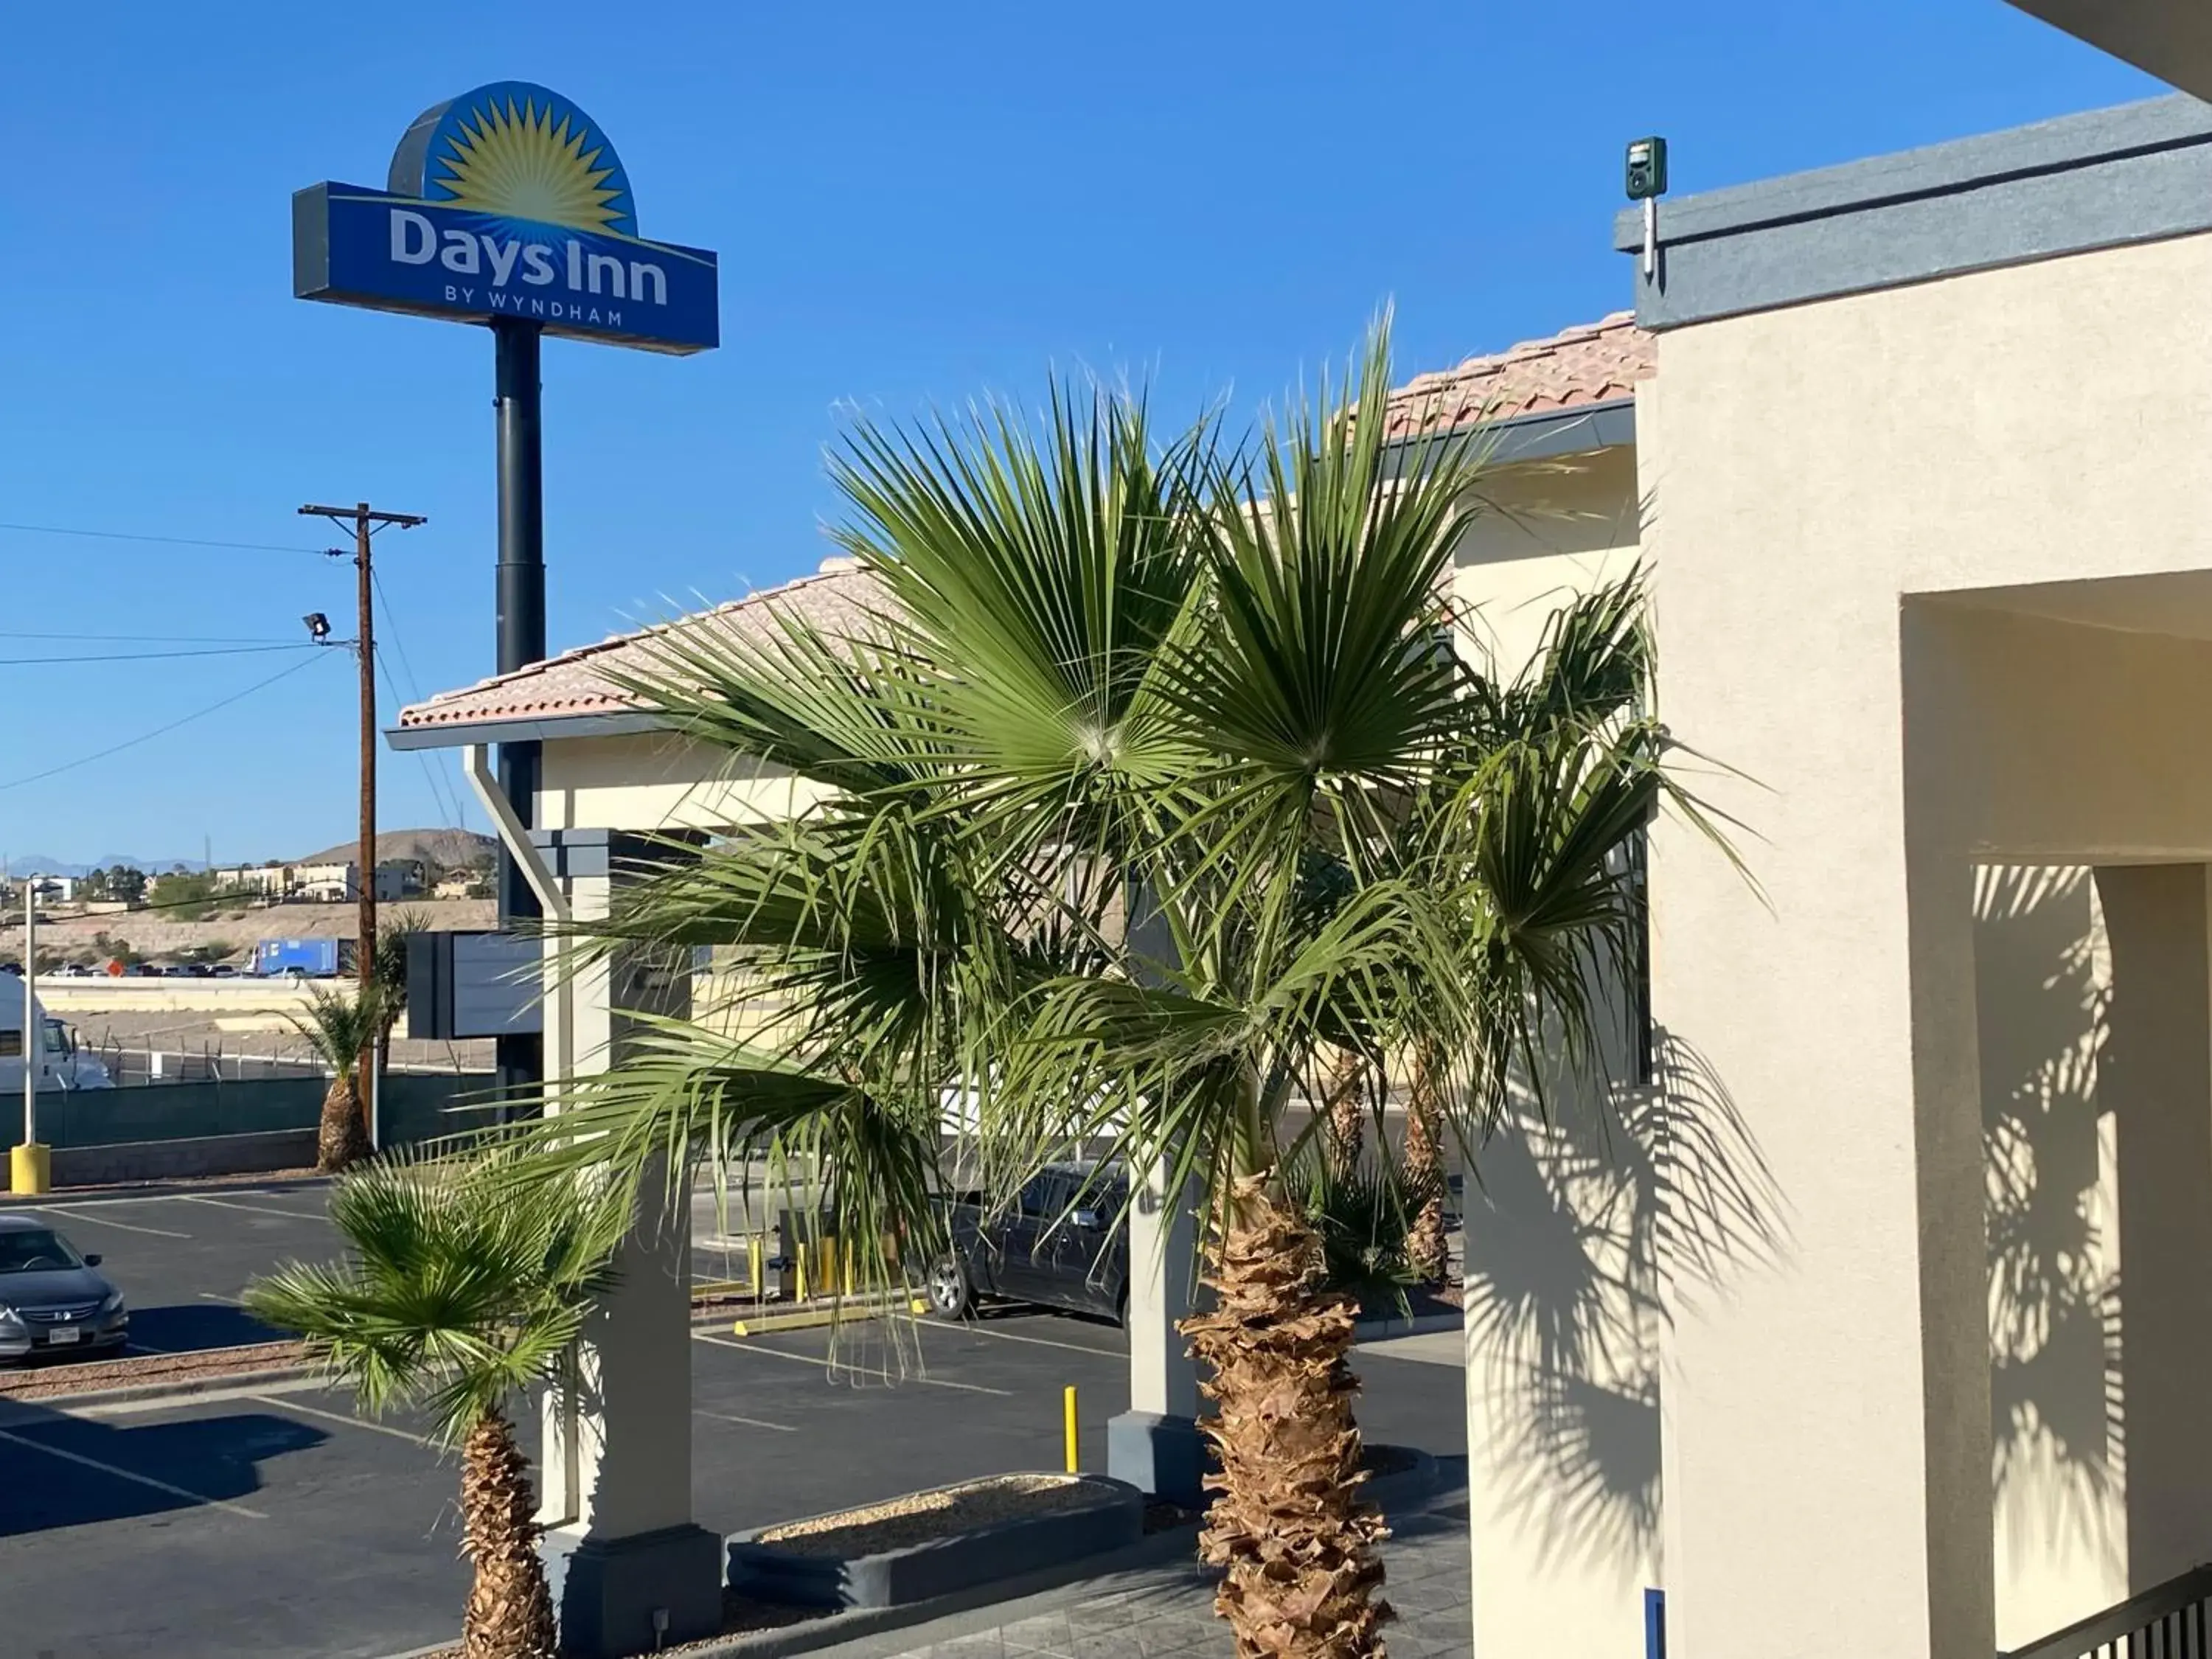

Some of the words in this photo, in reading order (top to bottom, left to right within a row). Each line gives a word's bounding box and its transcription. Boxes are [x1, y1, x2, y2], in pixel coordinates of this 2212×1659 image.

[390, 209, 554, 286] Days
[567, 240, 667, 305] Inn
[445, 286, 474, 304] BY
[489, 292, 622, 326] WYNDHAM
